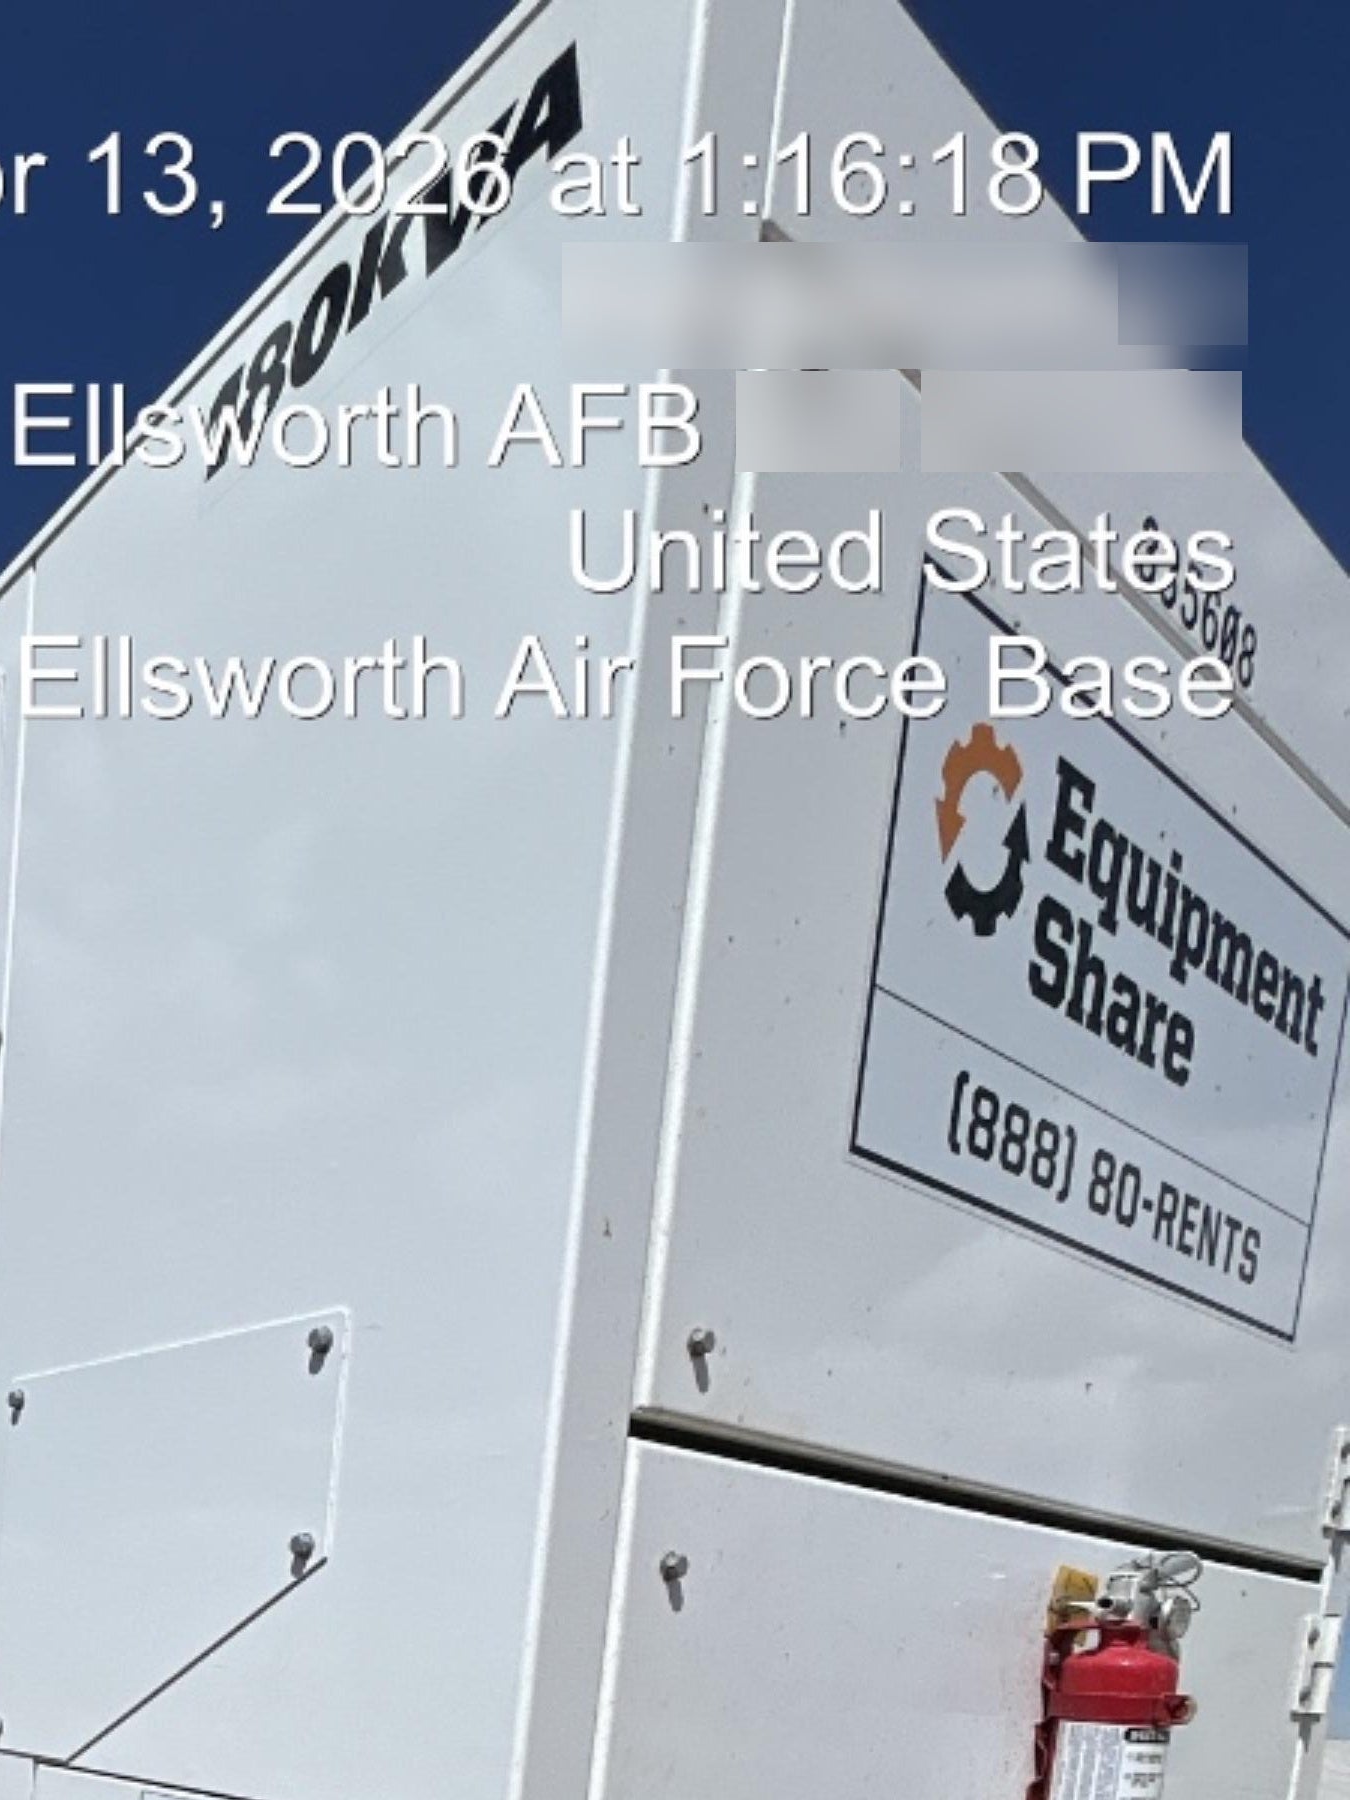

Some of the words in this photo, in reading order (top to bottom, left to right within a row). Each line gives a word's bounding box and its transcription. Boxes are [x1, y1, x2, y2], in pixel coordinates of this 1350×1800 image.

[1028, 894, 1195, 1087] Share
[1044, 757, 1325, 1057] Equipment
[947, 1070, 1077, 1202] (888)
[1089, 1148, 1260, 1286] 80-RENTS
